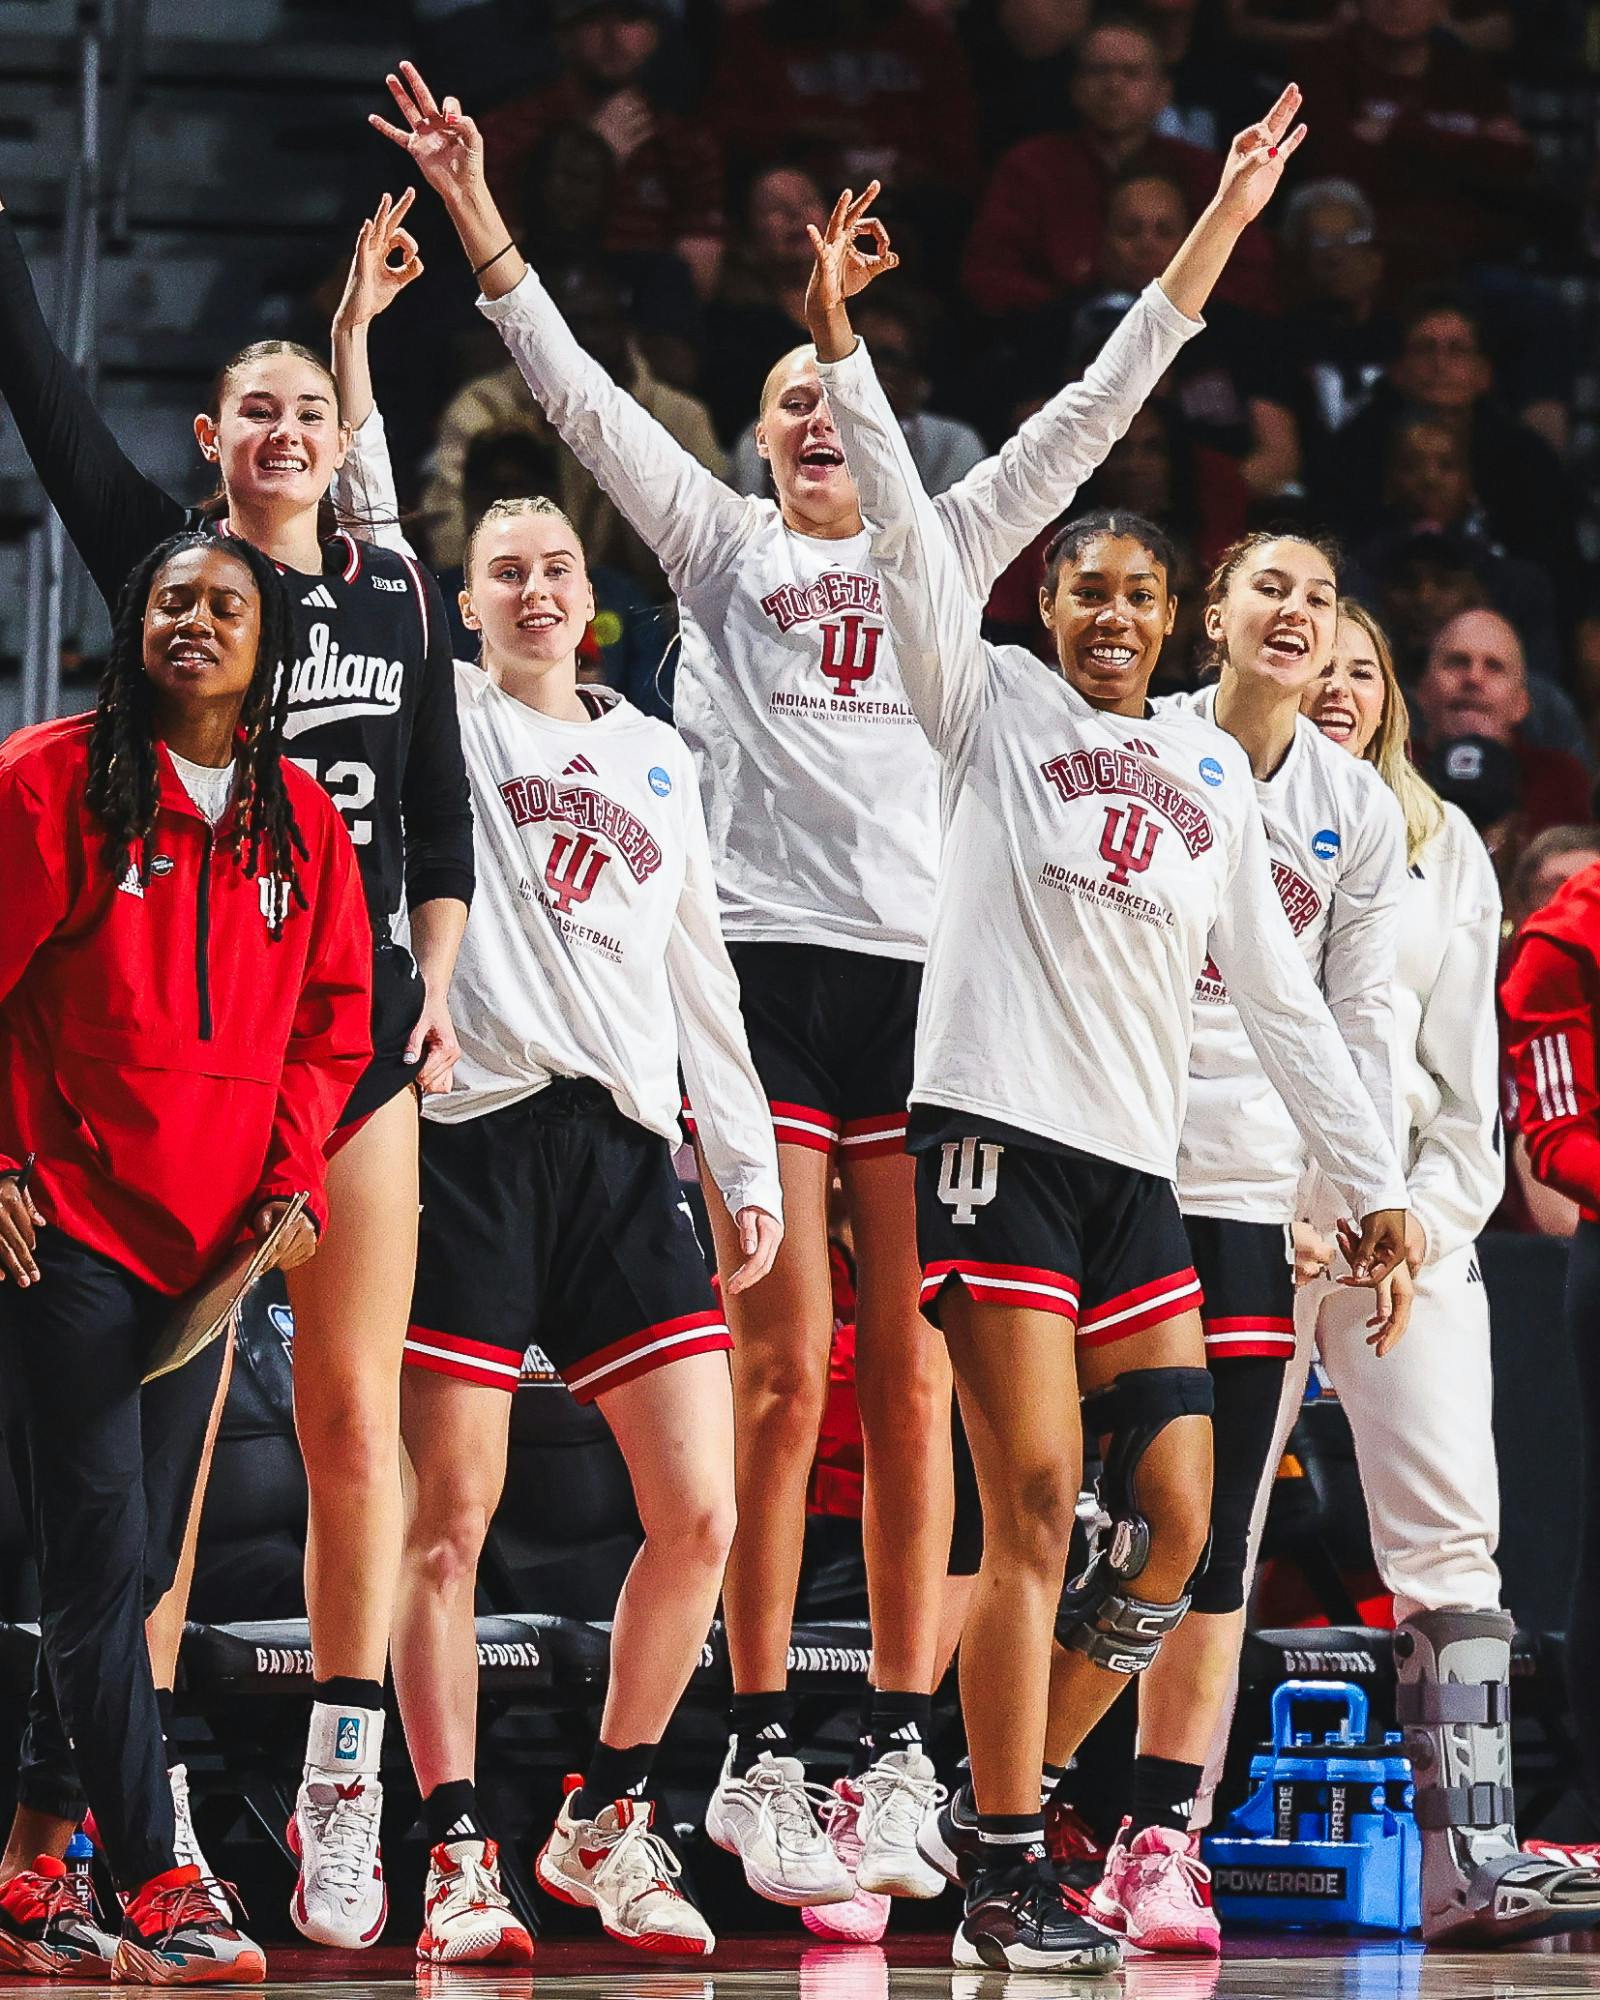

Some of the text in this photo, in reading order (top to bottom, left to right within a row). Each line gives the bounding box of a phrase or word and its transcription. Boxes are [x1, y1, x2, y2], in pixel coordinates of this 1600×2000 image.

[760, 571, 883, 634] TOGETH
[271, 622, 404, 704] ndiana
[769, 705, 809, 718] INDIANA
[771, 691, 827, 710] INDIANA
[287, 757, 377, 845] 2
[1038, 875, 1075, 897] INDIANA
[1042, 862, 1095, 893] INDIANA
[255, 1647, 315, 1674] GAMEC
[475, 1642, 540, 1667] ECOCKS
[786, 1646, 873, 1672] GAMECOCK
[1278, 1786, 1294, 1840] RADE
[1331, 1786, 1346, 1844] RADE
[1213, 1870, 1339, 1894] POWERADE
